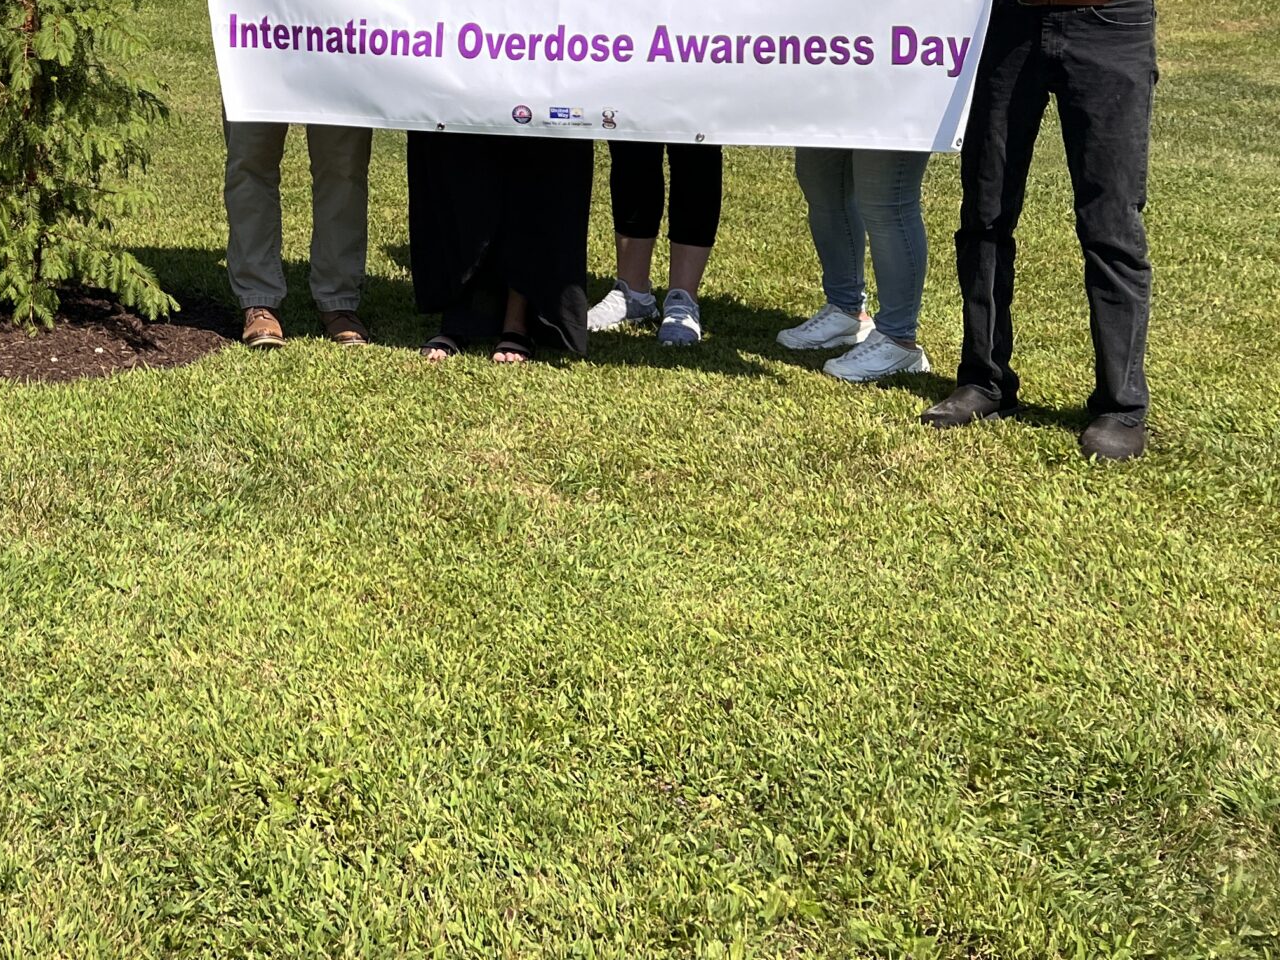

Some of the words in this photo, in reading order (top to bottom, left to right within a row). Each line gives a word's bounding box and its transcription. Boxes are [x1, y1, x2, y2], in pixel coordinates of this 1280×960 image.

[228, 13, 445, 59] International
[457, 22, 634, 63] Overdose
[646, 24, 875, 66] Awareness
[891, 25, 971, 78] Day
